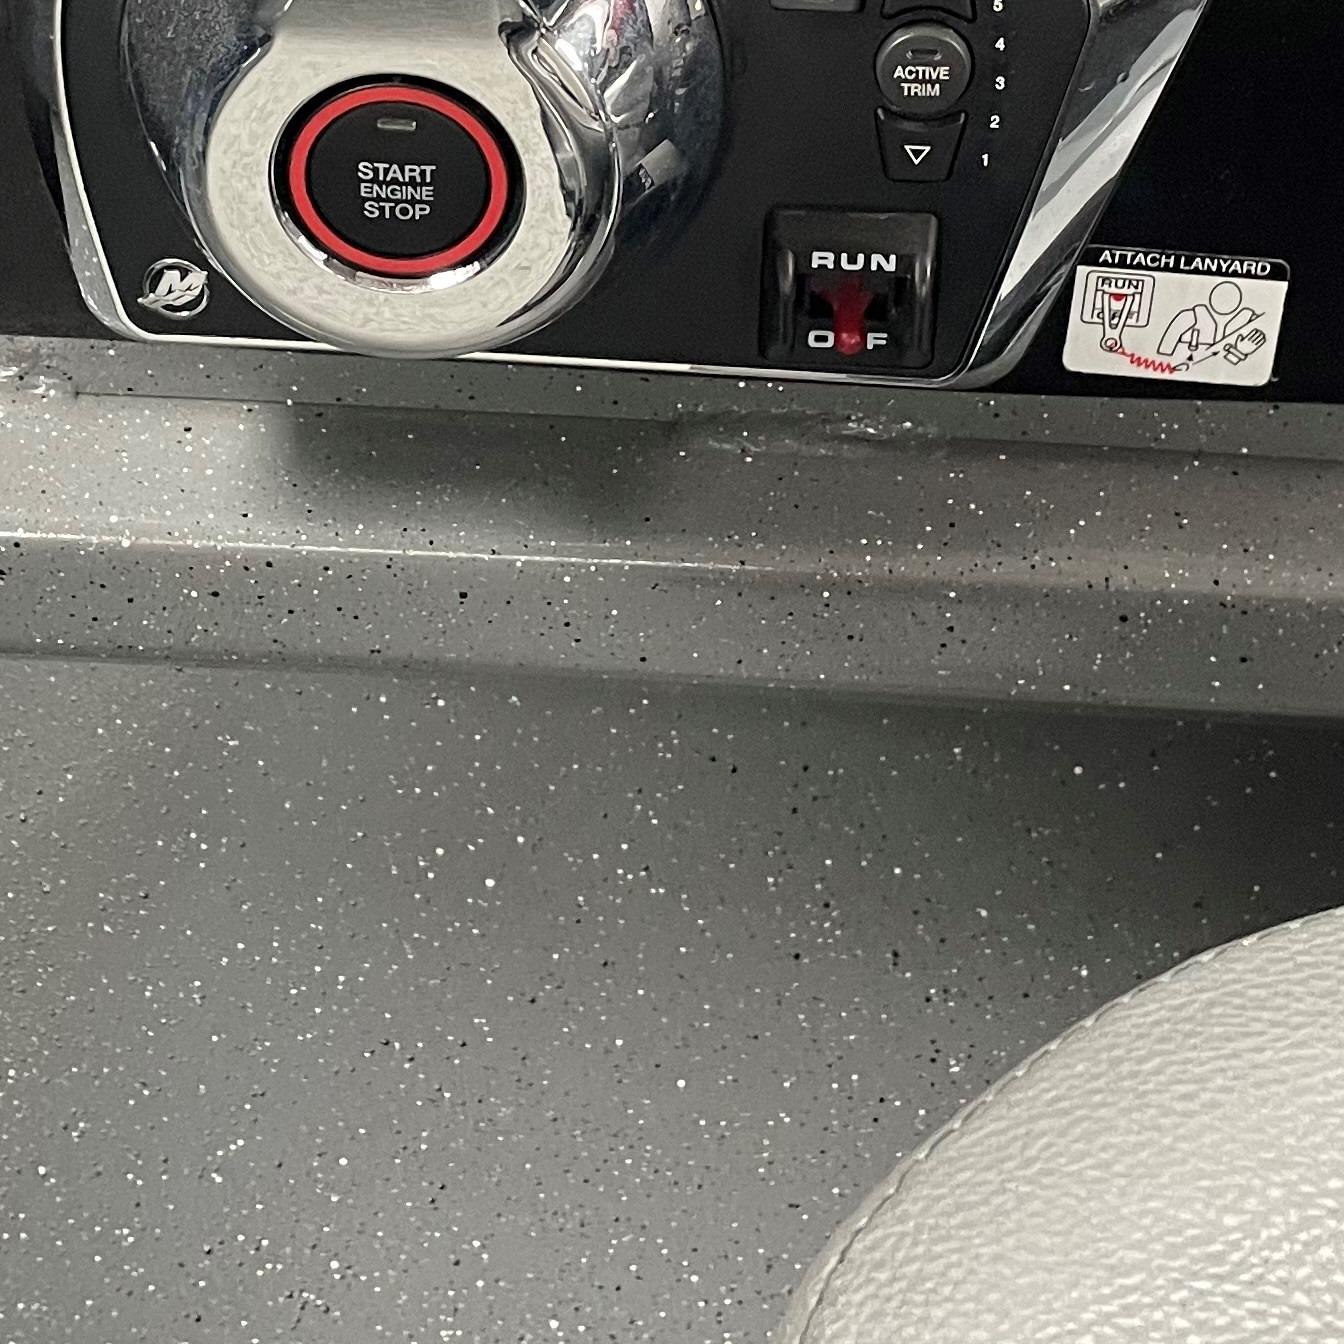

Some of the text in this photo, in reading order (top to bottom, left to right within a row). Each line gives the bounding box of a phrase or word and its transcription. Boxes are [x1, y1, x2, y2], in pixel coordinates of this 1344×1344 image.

[995, 37, 1006, 51] 4
[893, 65, 950, 80] ACTIVE
[900, 82, 940, 97] TRIM
[995, 77, 1006, 90] 3
[990, 115, 1000, 129] 2
[981, 153, 989, 167] 1
[357, 161, 437, 183] START
[360, 182, 434, 201] ENGINE
[364, 201, 430, 220] STOP
[811, 251, 897, 272] RUN
[1098, 250, 1271, 276] ATTACH LANYARD
[1101, 277, 1139, 290] RUN
[807, 329, 888, 350] OF
